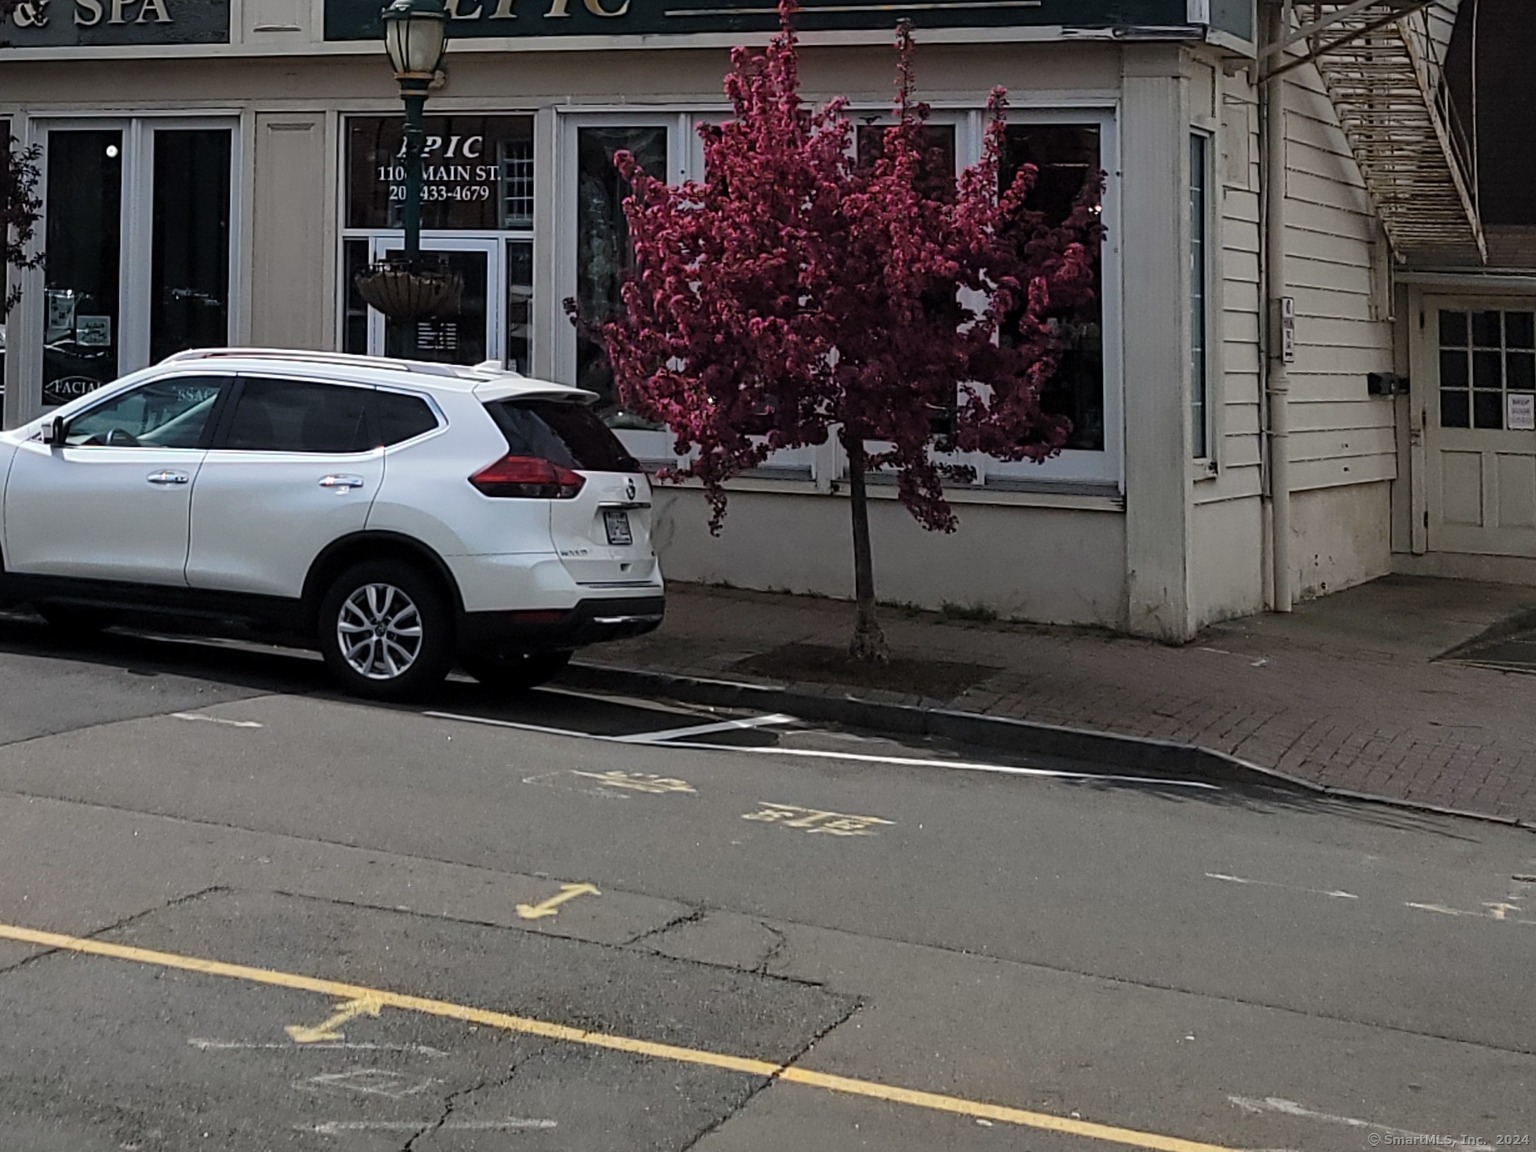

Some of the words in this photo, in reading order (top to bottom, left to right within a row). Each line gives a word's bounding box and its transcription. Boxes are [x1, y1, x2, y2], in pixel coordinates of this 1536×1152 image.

[378, 166, 408, 181] 110
[422, 165, 471, 181] MAIN
[475, 165, 501, 181] ST.
